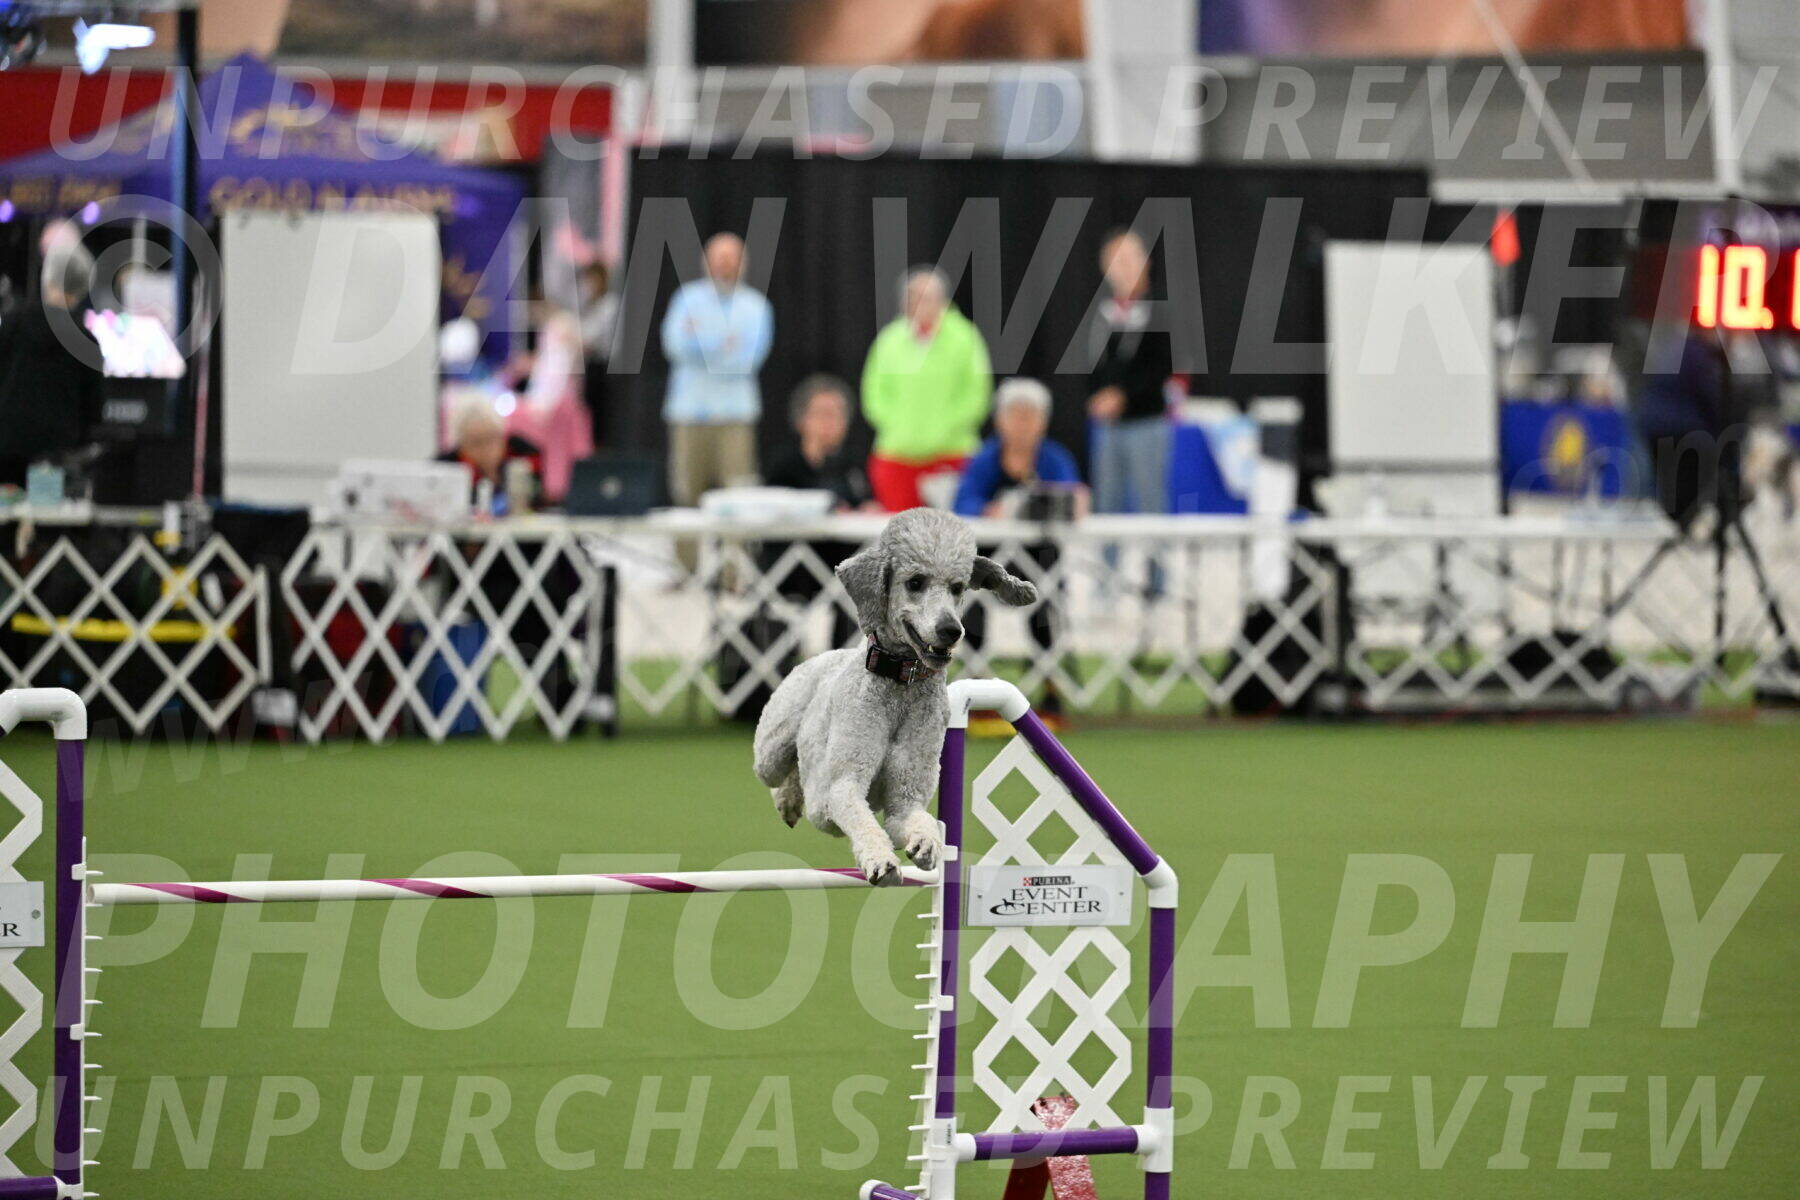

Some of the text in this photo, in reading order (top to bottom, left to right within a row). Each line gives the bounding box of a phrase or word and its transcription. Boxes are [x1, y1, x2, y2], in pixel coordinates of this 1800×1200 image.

[1032, 875, 1071, 886] PURINA
[1011, 886, 1088, 901] EVENT
[989, 900, 1102, 916] CENTER
